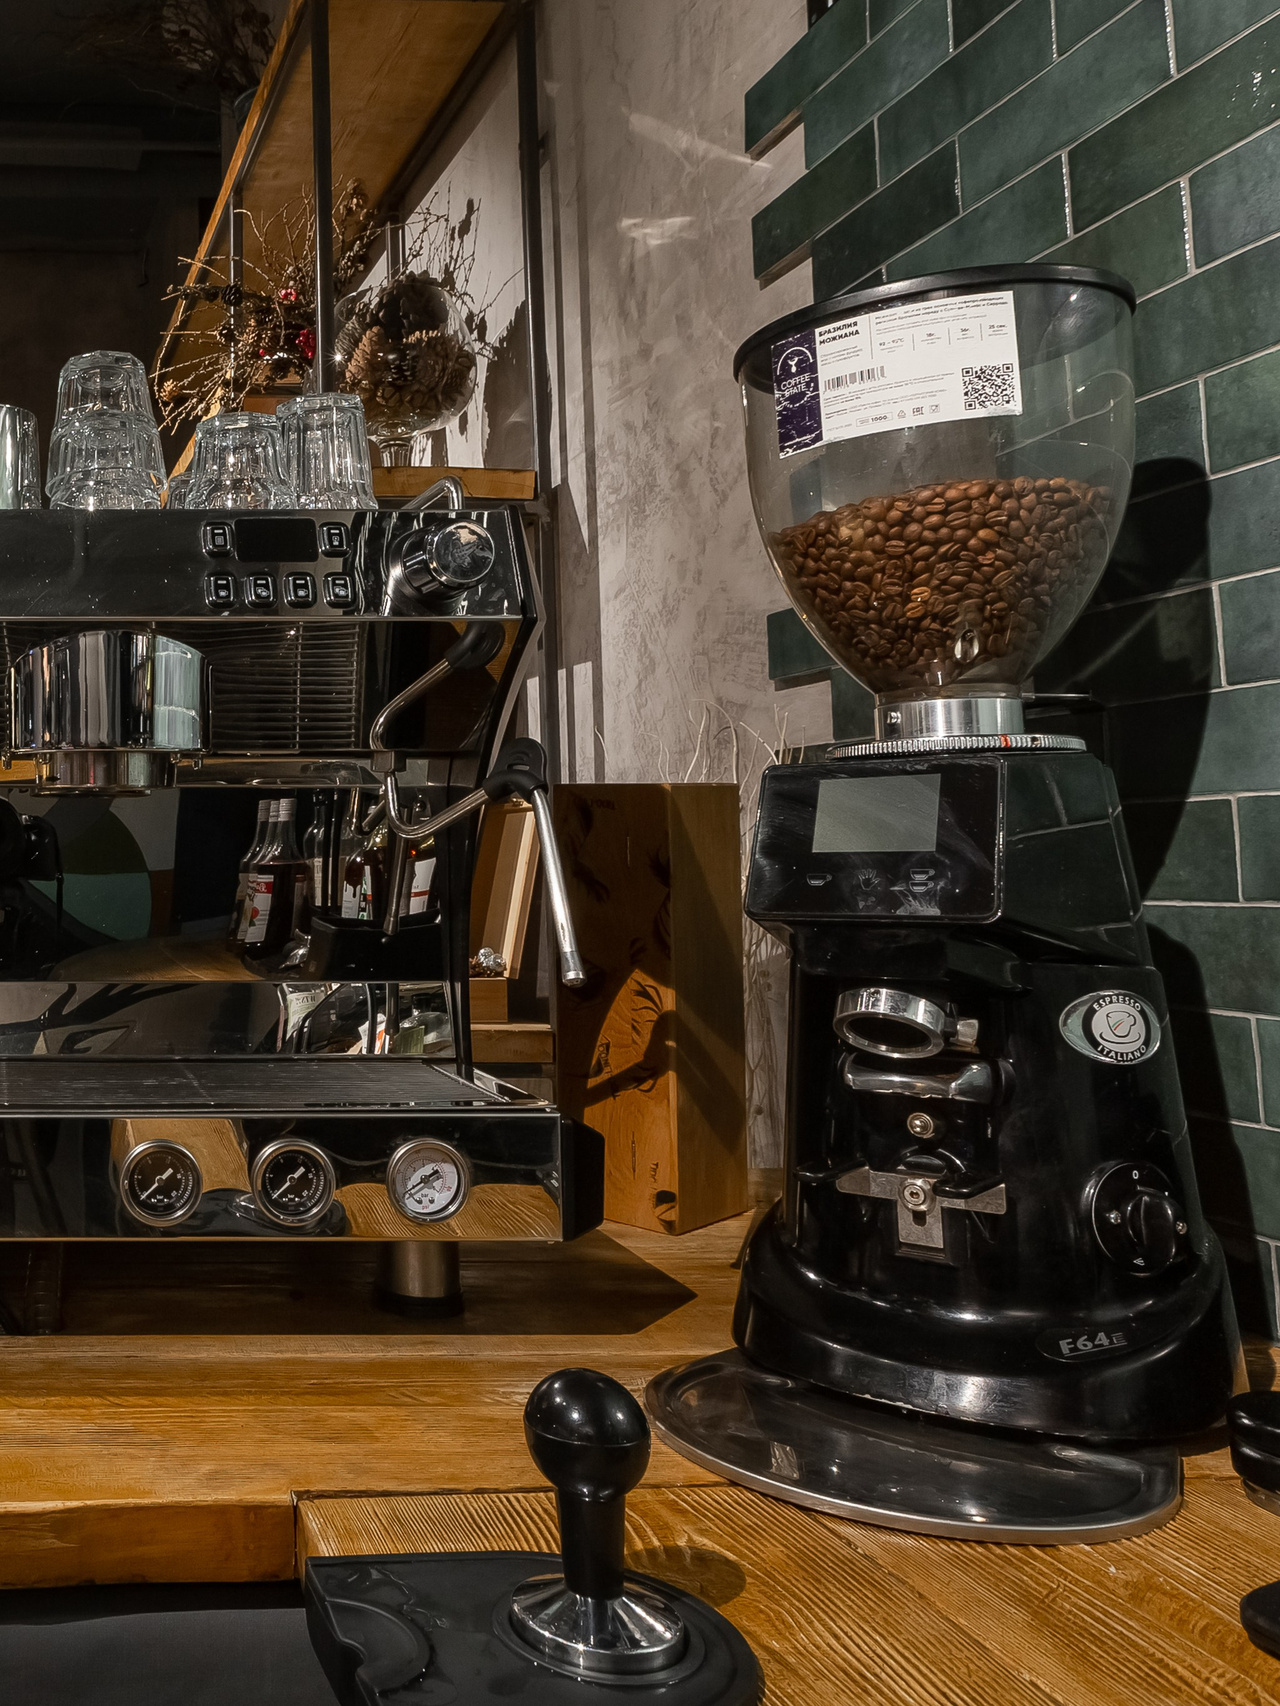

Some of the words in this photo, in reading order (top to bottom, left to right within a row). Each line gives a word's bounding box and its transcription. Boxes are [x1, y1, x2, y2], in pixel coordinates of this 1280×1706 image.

[819, 321, 858, 337] БРАЗИЛИЯ
[819, 329, 860, 345] МОЖИАНА
[781, 372, 811, 390] COFFEE
[784, 382, 808, 397] STATE
[871, 414, 888, 423] 1000
[1093, 995, 1141, 1011] ESPRESSO
[1097, 1044, 1147, 1061] ITALIANO
